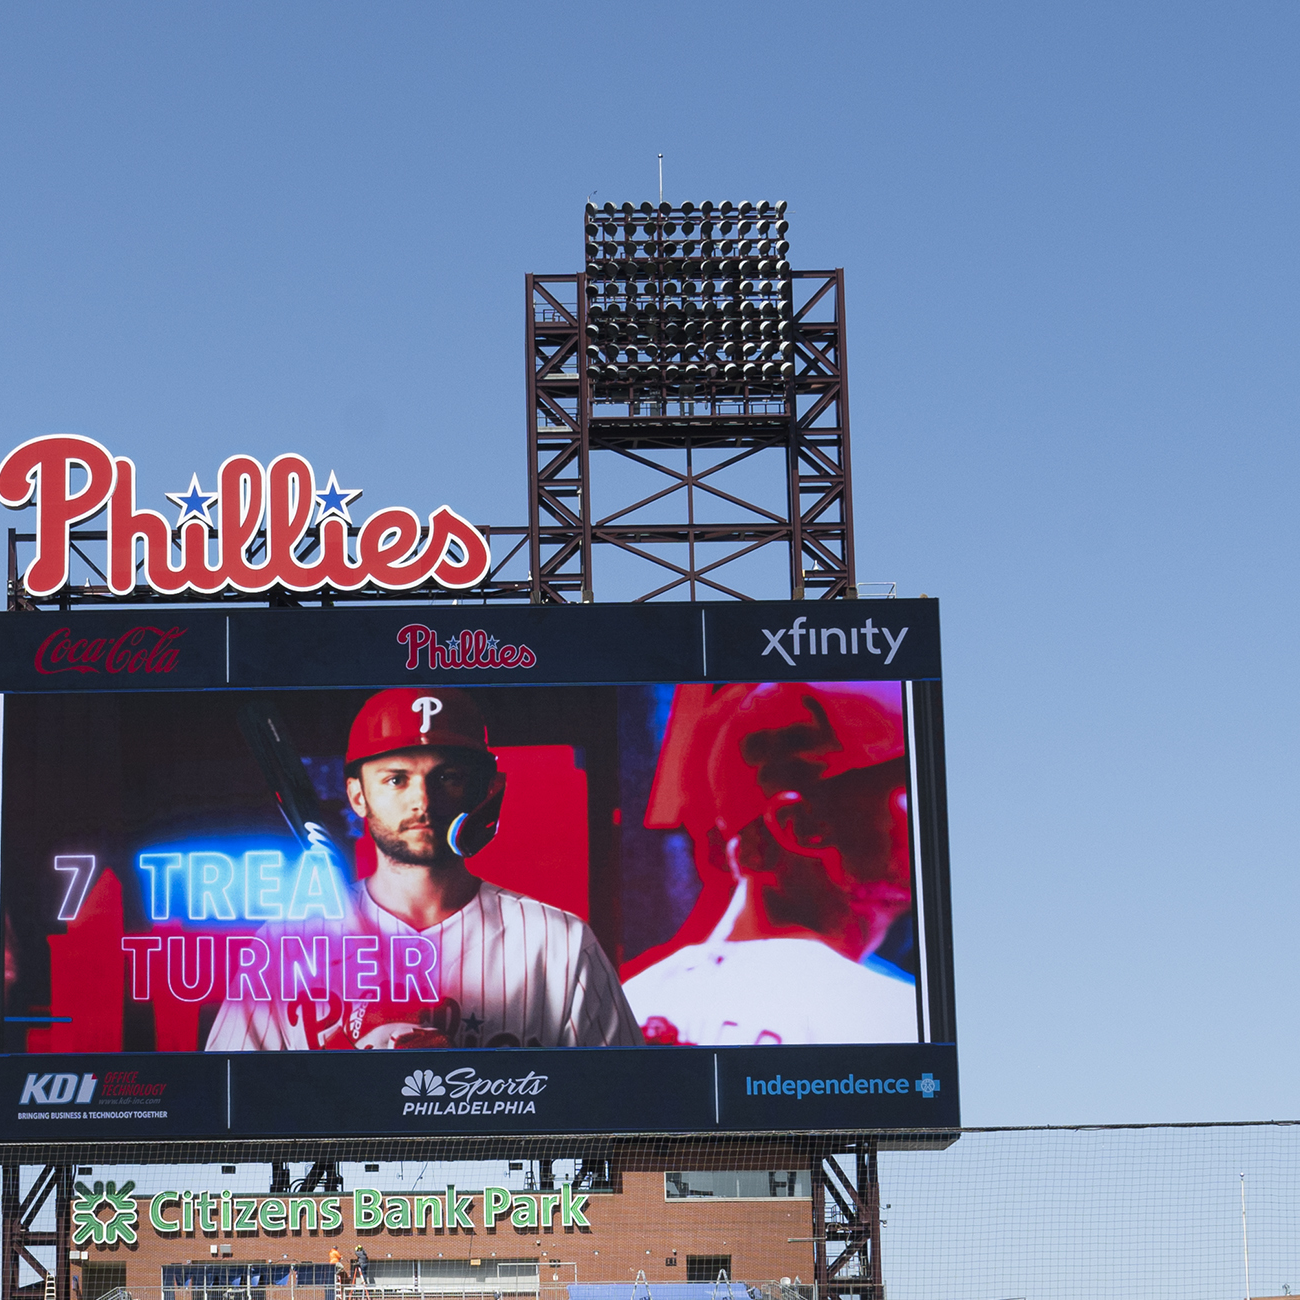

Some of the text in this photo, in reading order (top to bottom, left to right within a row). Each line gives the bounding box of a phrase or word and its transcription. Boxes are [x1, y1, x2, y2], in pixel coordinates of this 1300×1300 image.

[34, 626, 188, 674] Coca-Cola
[397, 623, 536, 669] Phillies
[760, 615, 909, 666] xfinity
[54, 855, 95, 920] 7
[139, 851, 344, 920] TREA
[121, 936, 439, 1002] TURNER
[19, 1073, 98, 1104] KDI
[101, 1084, 167, 1096] TECHNOLOGY
[104, 1071, 139, 1084] OFFICE
[443, 1067, 548, 1104] Sports
[746, 1073, 909, 1099] Independence
[17, 1112, 50, 1120] BRINGING
[88, 1111, 133, 1119] TECHNOLOGY
[402, 1100, 536, 1115] PHILADELPHIA
[149, 1183, 590, 1231] Citizens Bank Park
